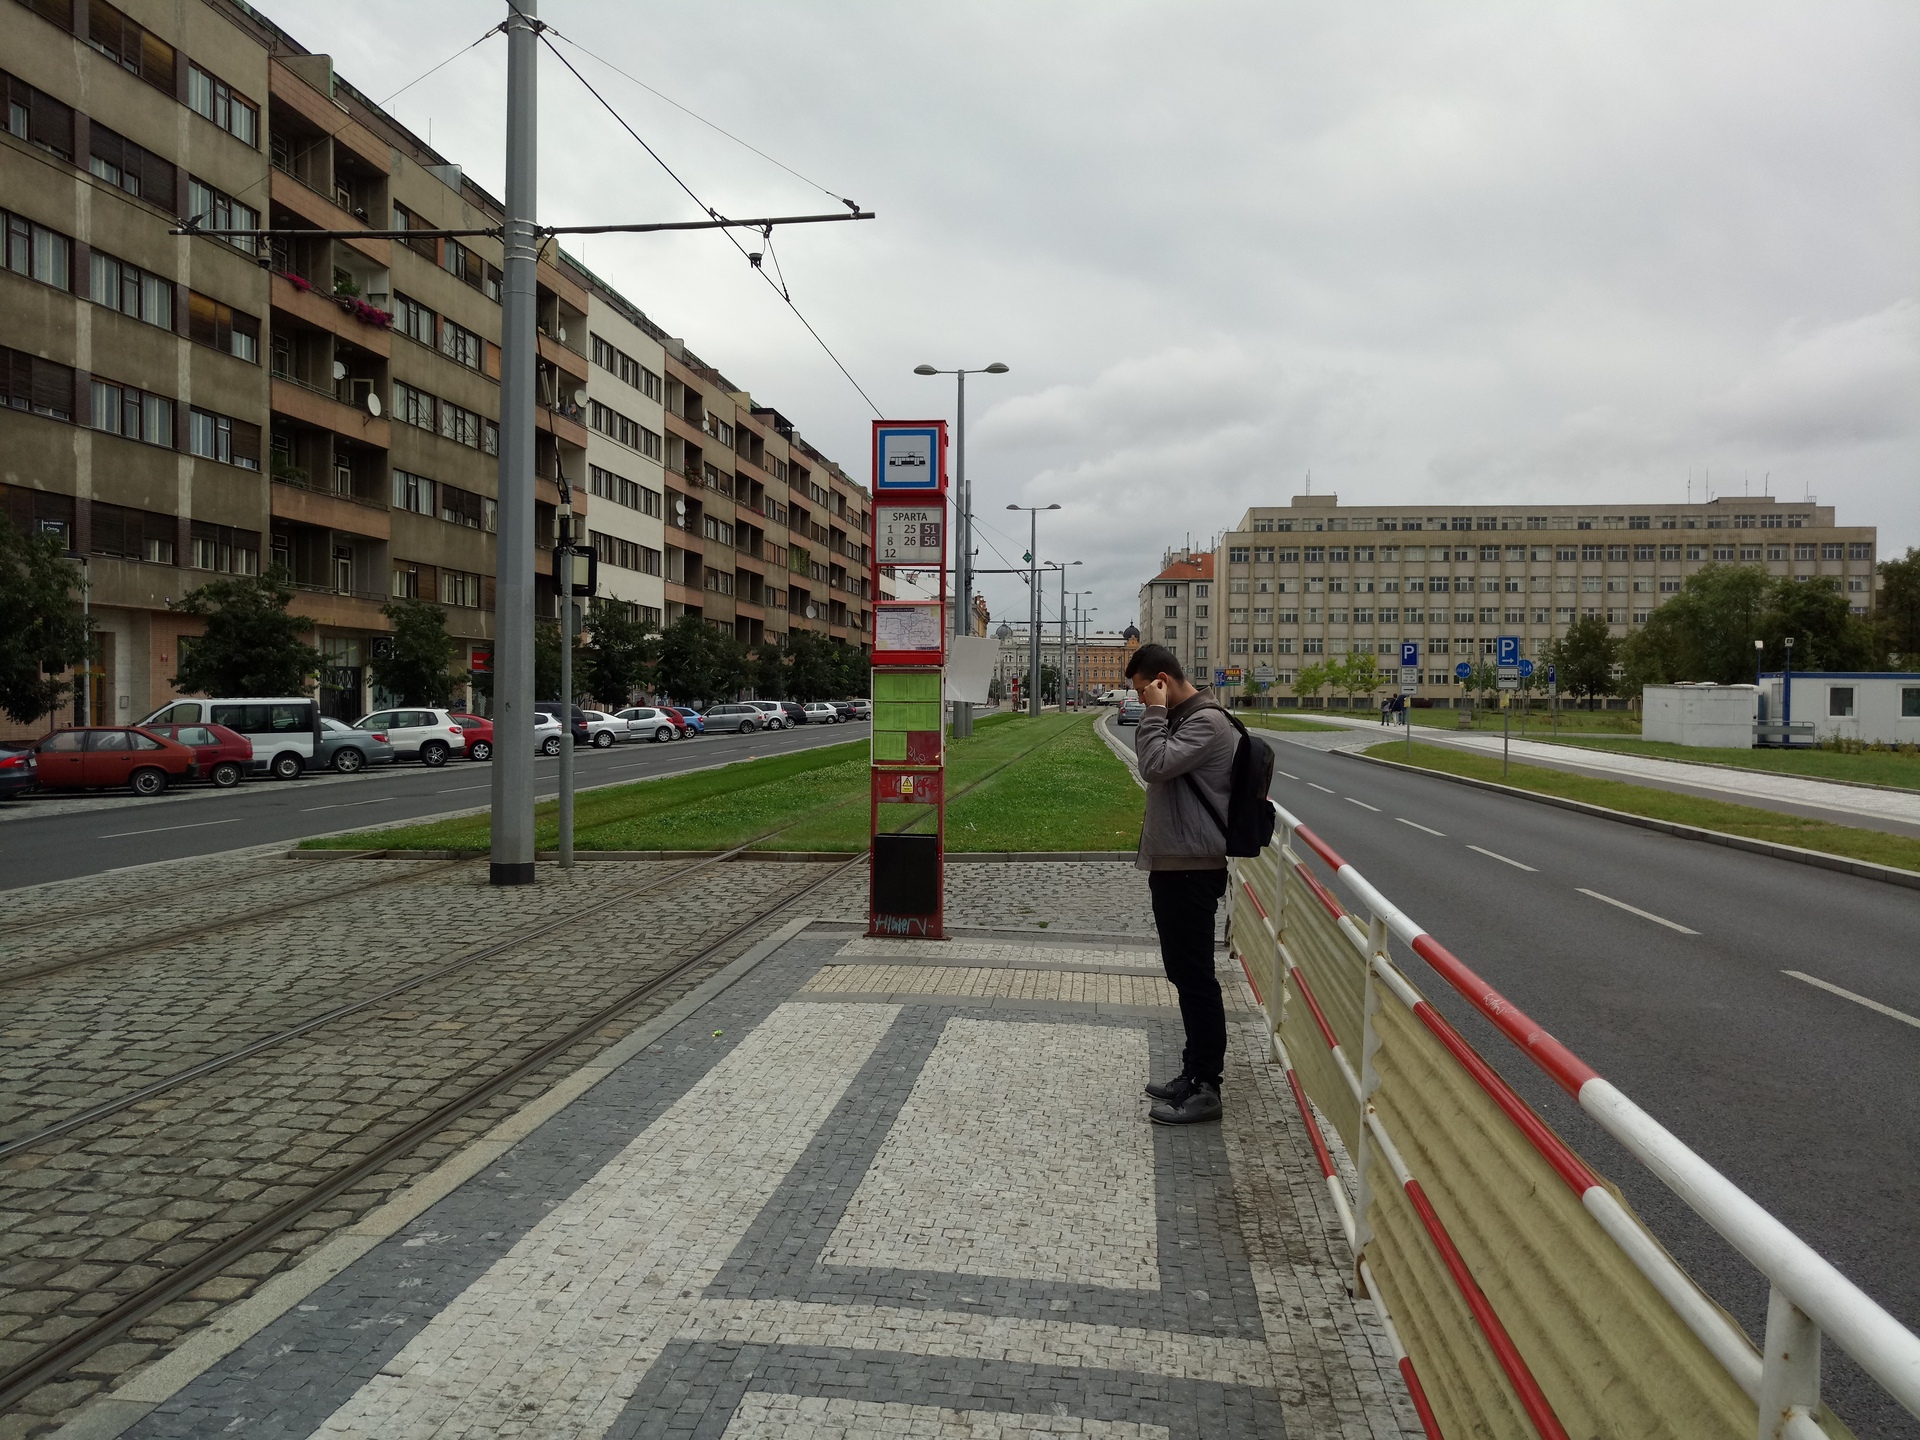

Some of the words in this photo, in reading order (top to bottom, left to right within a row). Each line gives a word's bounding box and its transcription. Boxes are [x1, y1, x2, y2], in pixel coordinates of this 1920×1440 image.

[892, 512, 928, 521] SPARTA
[887, 524, 893, 534] 1
[904, 524, 916, 534] 25
[924, 524, 936, 534] 51
[887, 536, 894, 546] 8
[903, 536, 916, 546] 26
[924, 536, 936, 546] 56
[884, 548, 896, 558] 12
[1403, 645, 1415, 660] P
[1501, 639, 1515, 657] P
